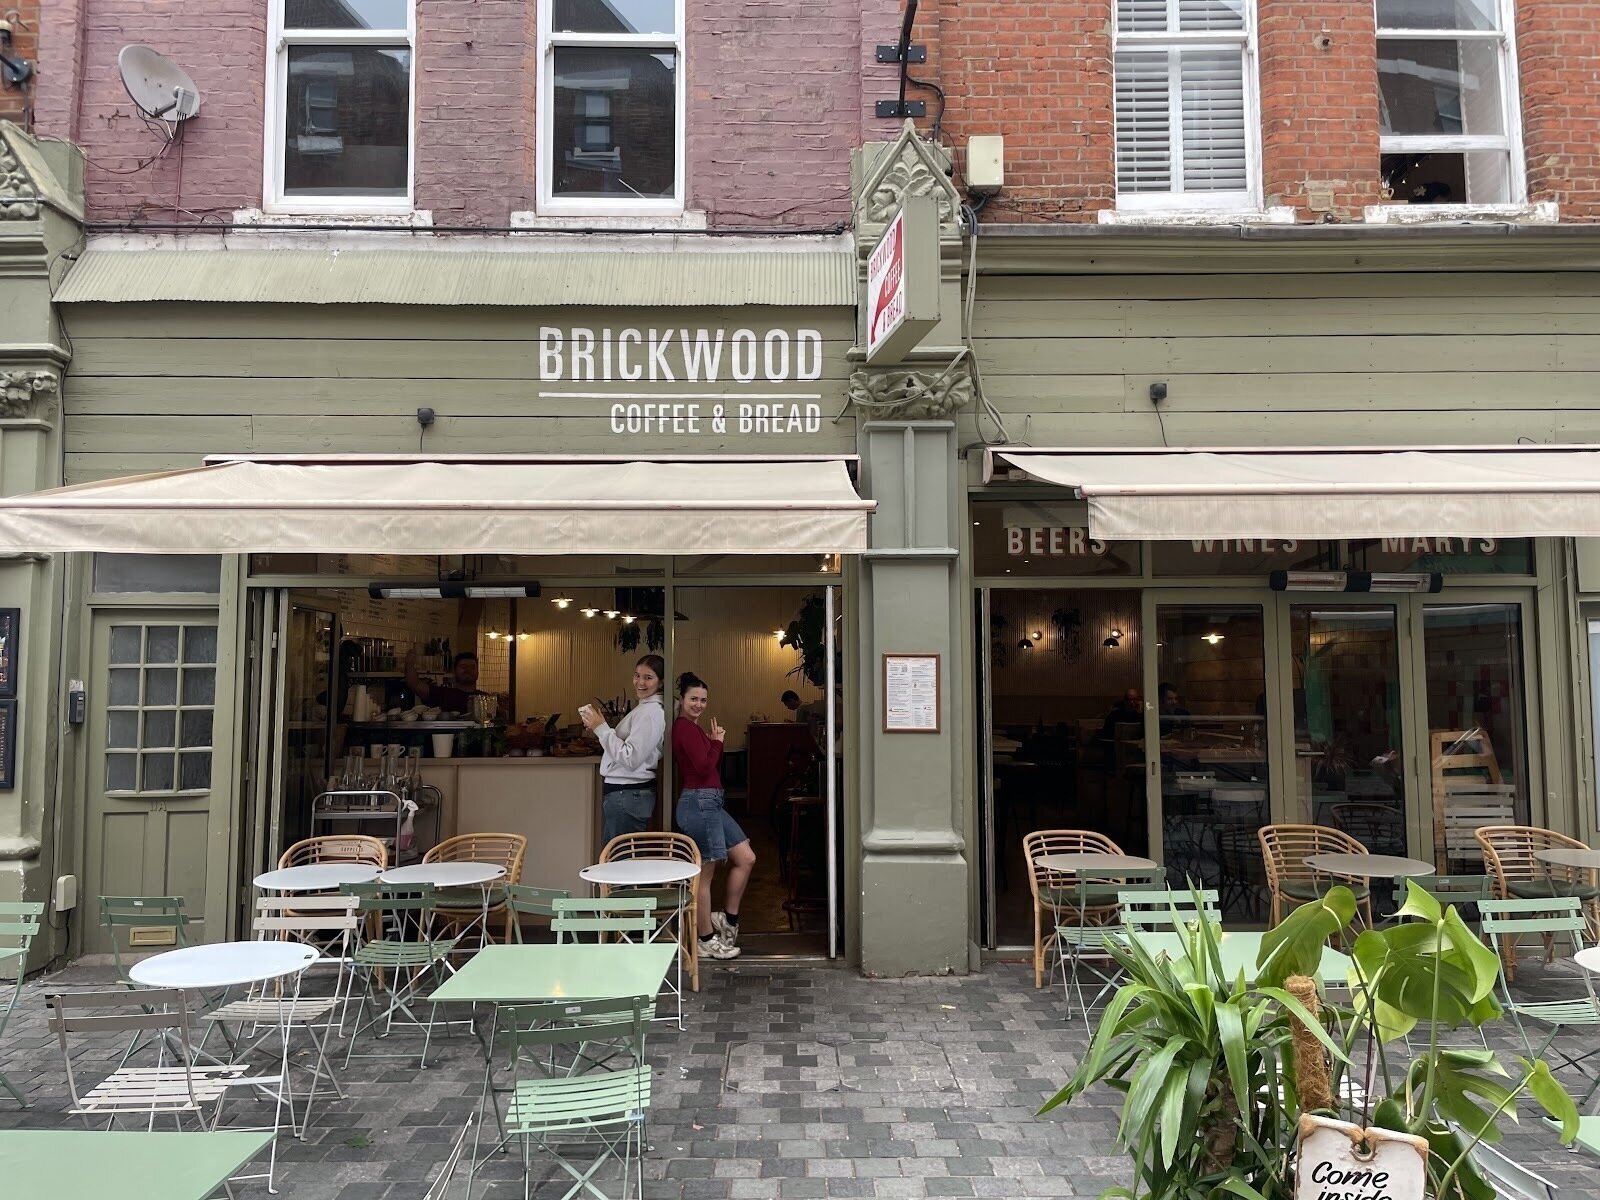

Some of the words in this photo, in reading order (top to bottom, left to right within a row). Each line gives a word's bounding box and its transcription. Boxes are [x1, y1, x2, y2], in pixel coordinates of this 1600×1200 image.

[884, 258, 902, 297] COFFEE
[887, 291, 902, 328] BREAD
[539, 326, 823, 383] BRICKWOOD
[610, 403, 700, 434] COFFEE
[712, 403, 726, 434] &
[739, 403, 821, 434] BREAD
[1006, 527, 1107, 555] BEERS
[1312, 1161, 1389, 1189] Come
[1317, 1186, 1393, 1200] insi
